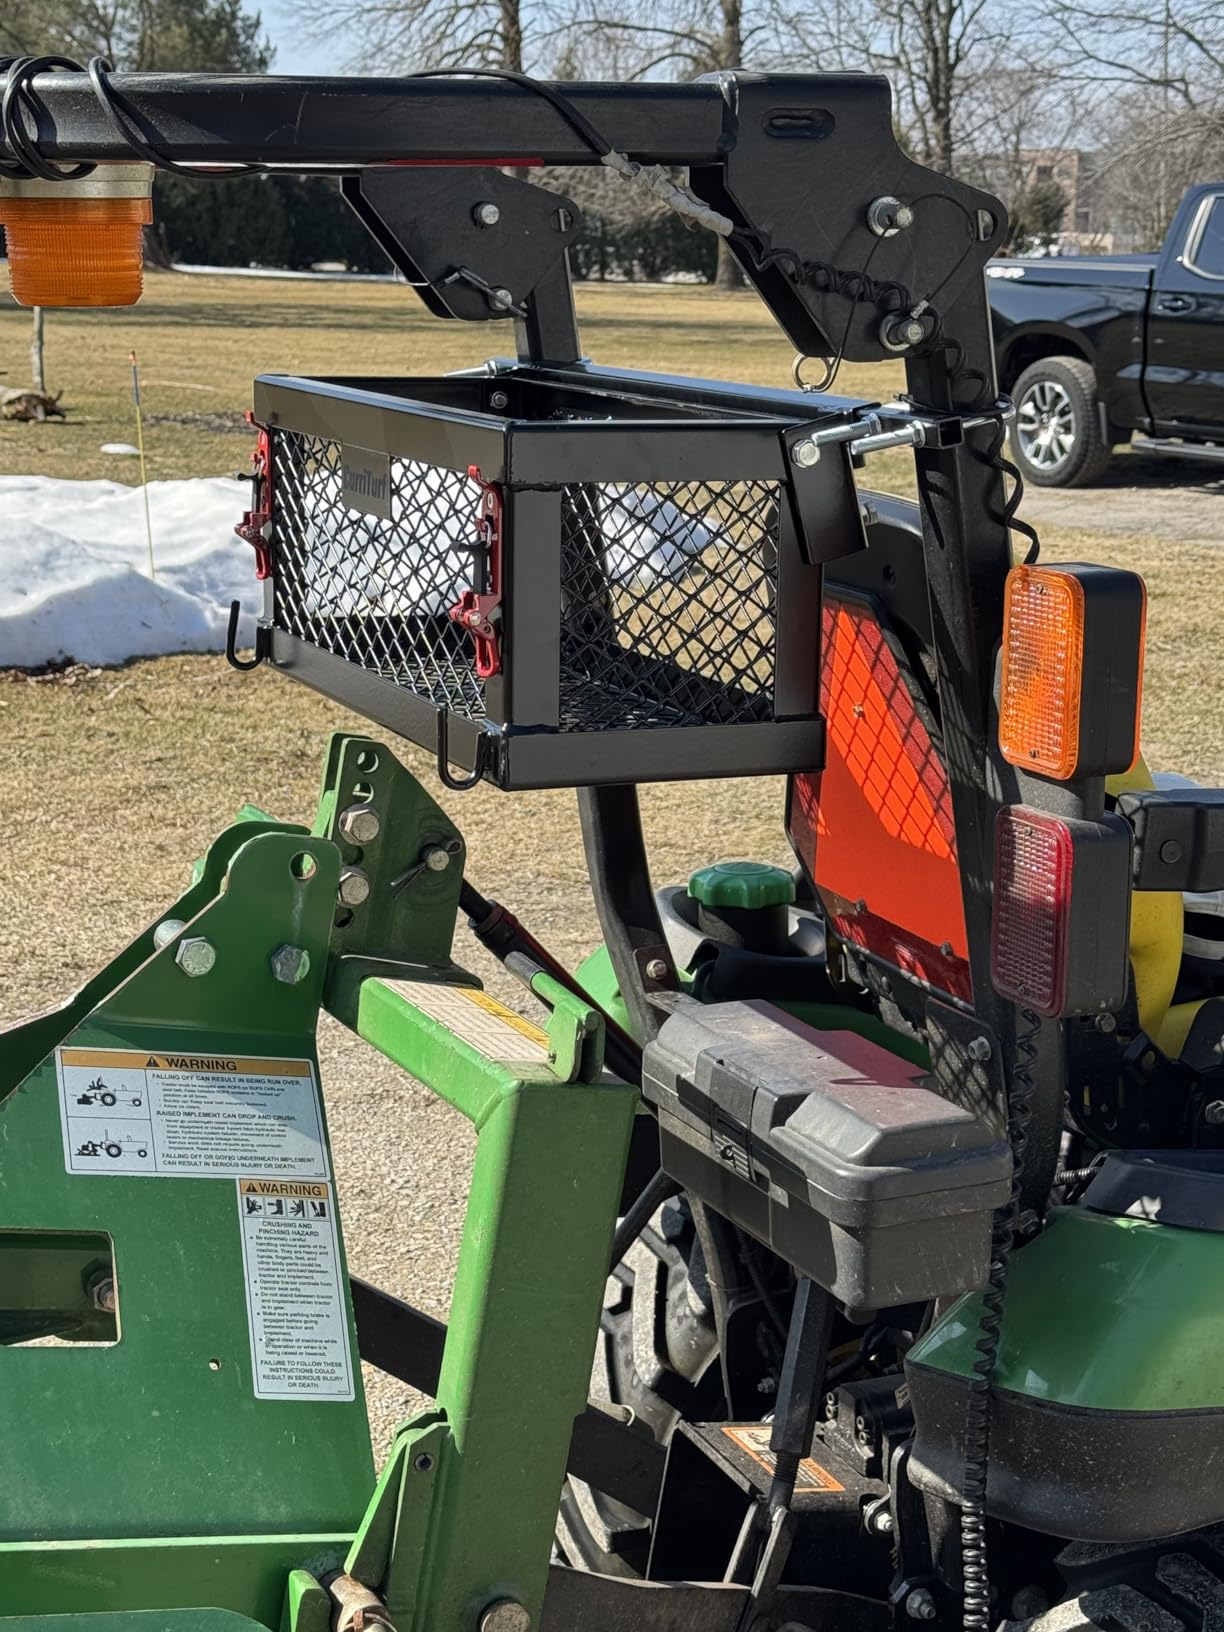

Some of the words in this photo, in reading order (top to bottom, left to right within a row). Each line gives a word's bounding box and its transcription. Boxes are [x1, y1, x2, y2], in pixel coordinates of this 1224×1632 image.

[165, 1057, 237, 1070] WARNING
[258, 1181, 321, 1196] WARNING
[262, 1220, 297, 1228] CRUSHING
[258, 1227, 290, 1235] PINCHING
[291, 1229, 319, 1237] HAZARD
